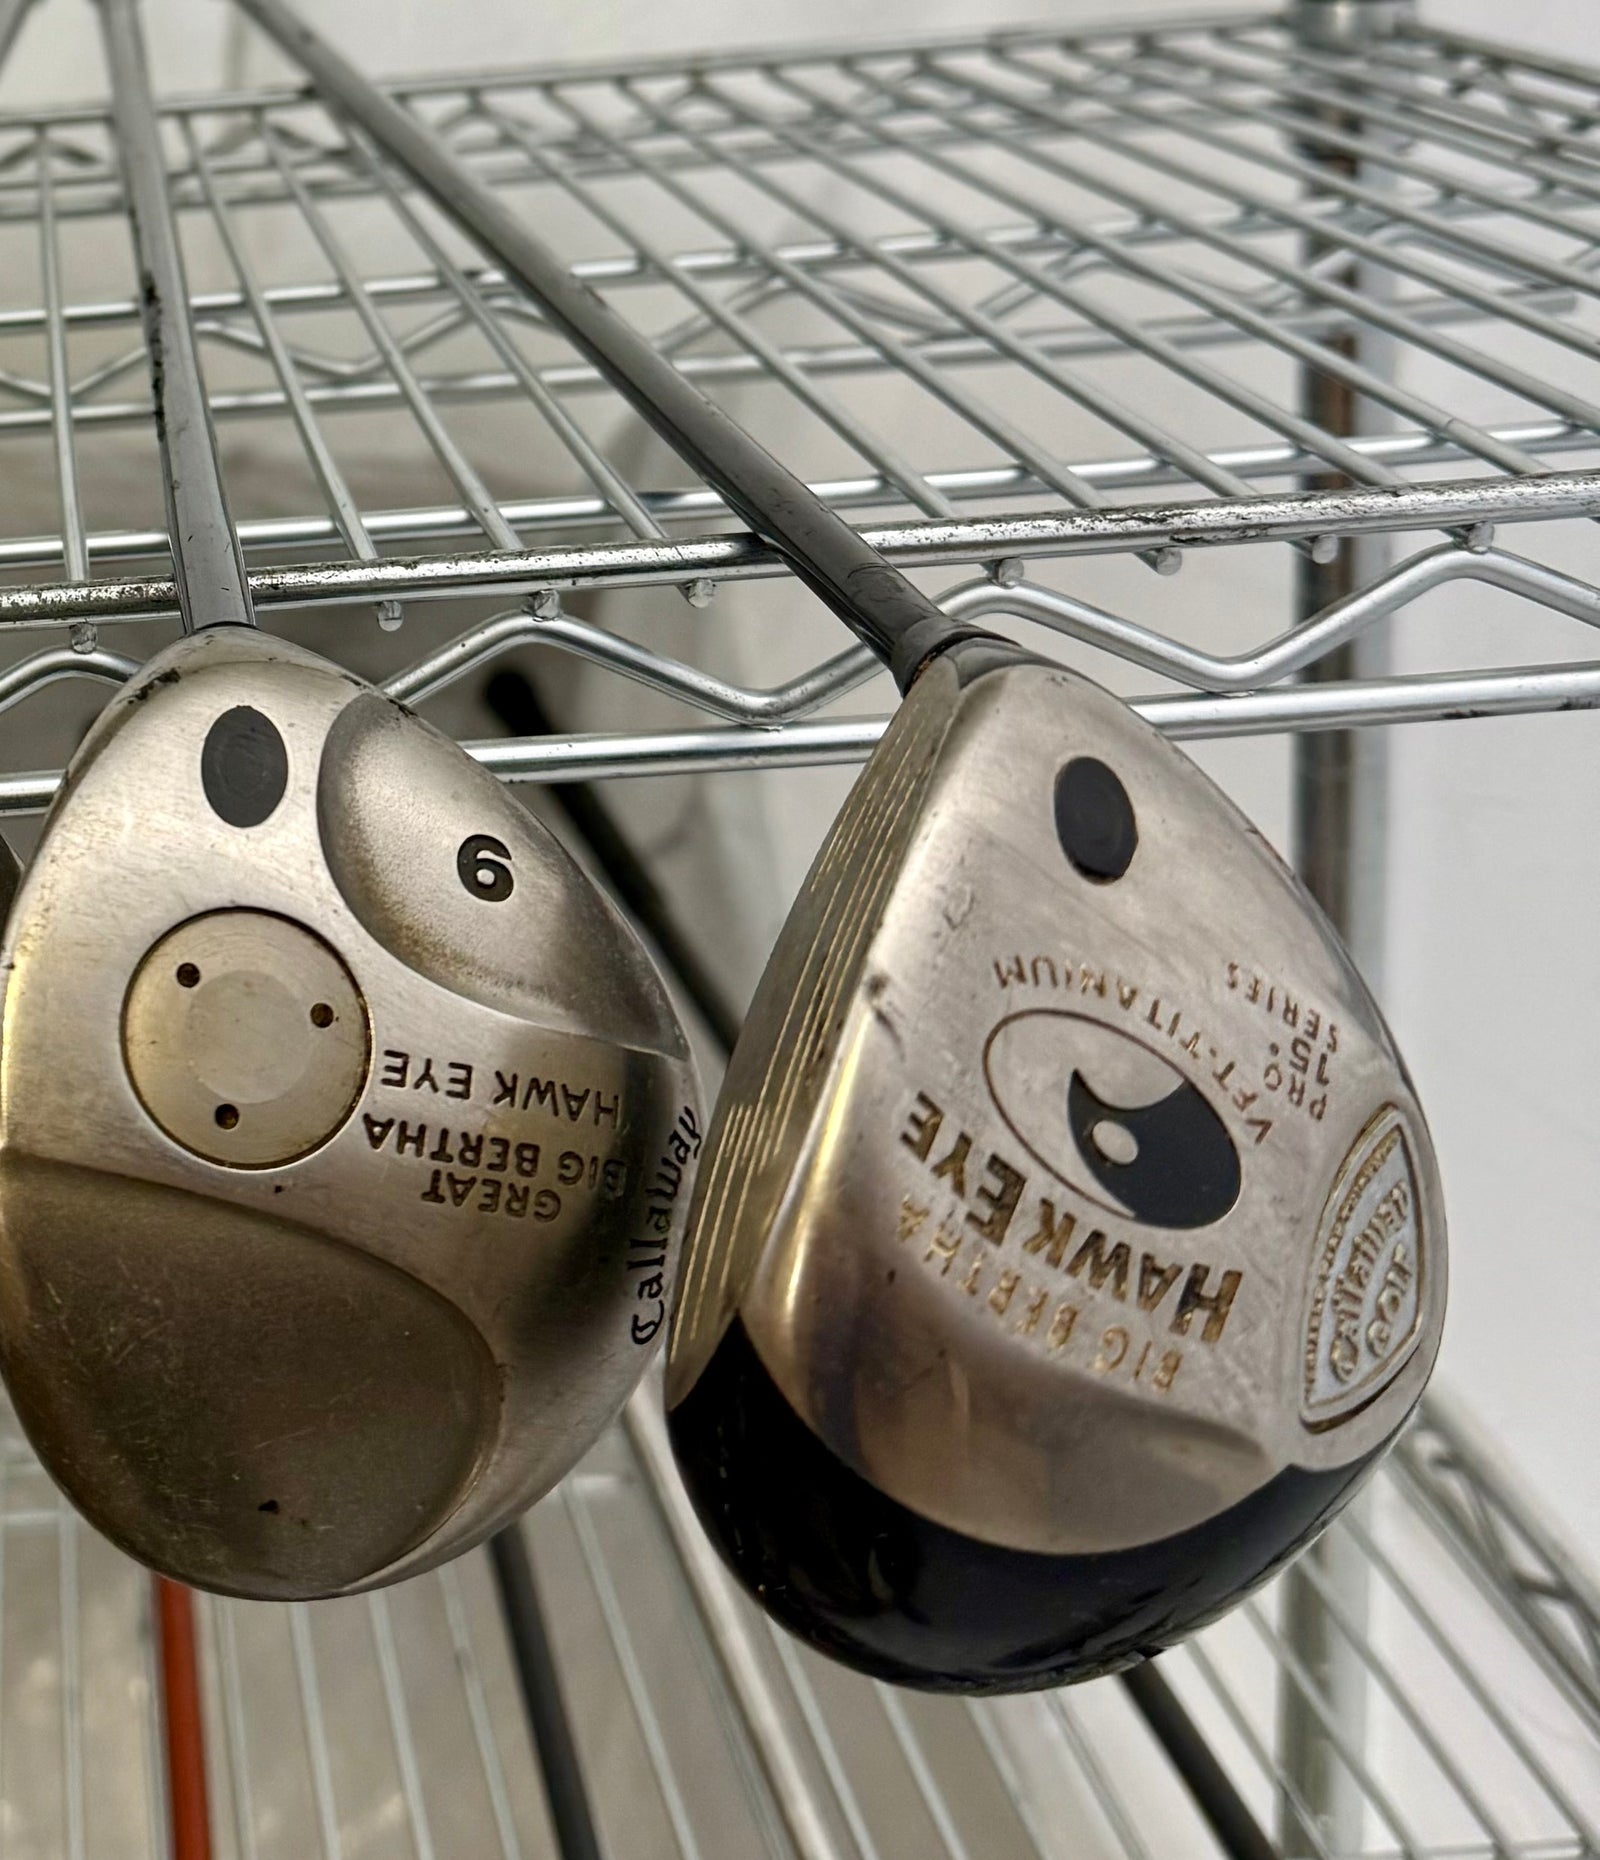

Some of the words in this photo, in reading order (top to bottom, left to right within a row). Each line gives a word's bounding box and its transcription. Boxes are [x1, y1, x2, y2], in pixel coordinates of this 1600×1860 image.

[1228, 962, 1339, 1053] SERIES
[381, 1049, 474, 1101] EYE
[493, 1070, 621, 1130] HAWK
[1263, 1062, 1328, 1122] PRO
[363, 1112, 541, 1179] BERTHA
[557, 1150, 628, 1199] BIG
[421, 1168, 562, 1223] GREAT
[626, 1105, 702, 1345] Callaway
[897, 1194, 1079, 1349] BERTHA
[1094, 1326, 1184, 1392] BIG
